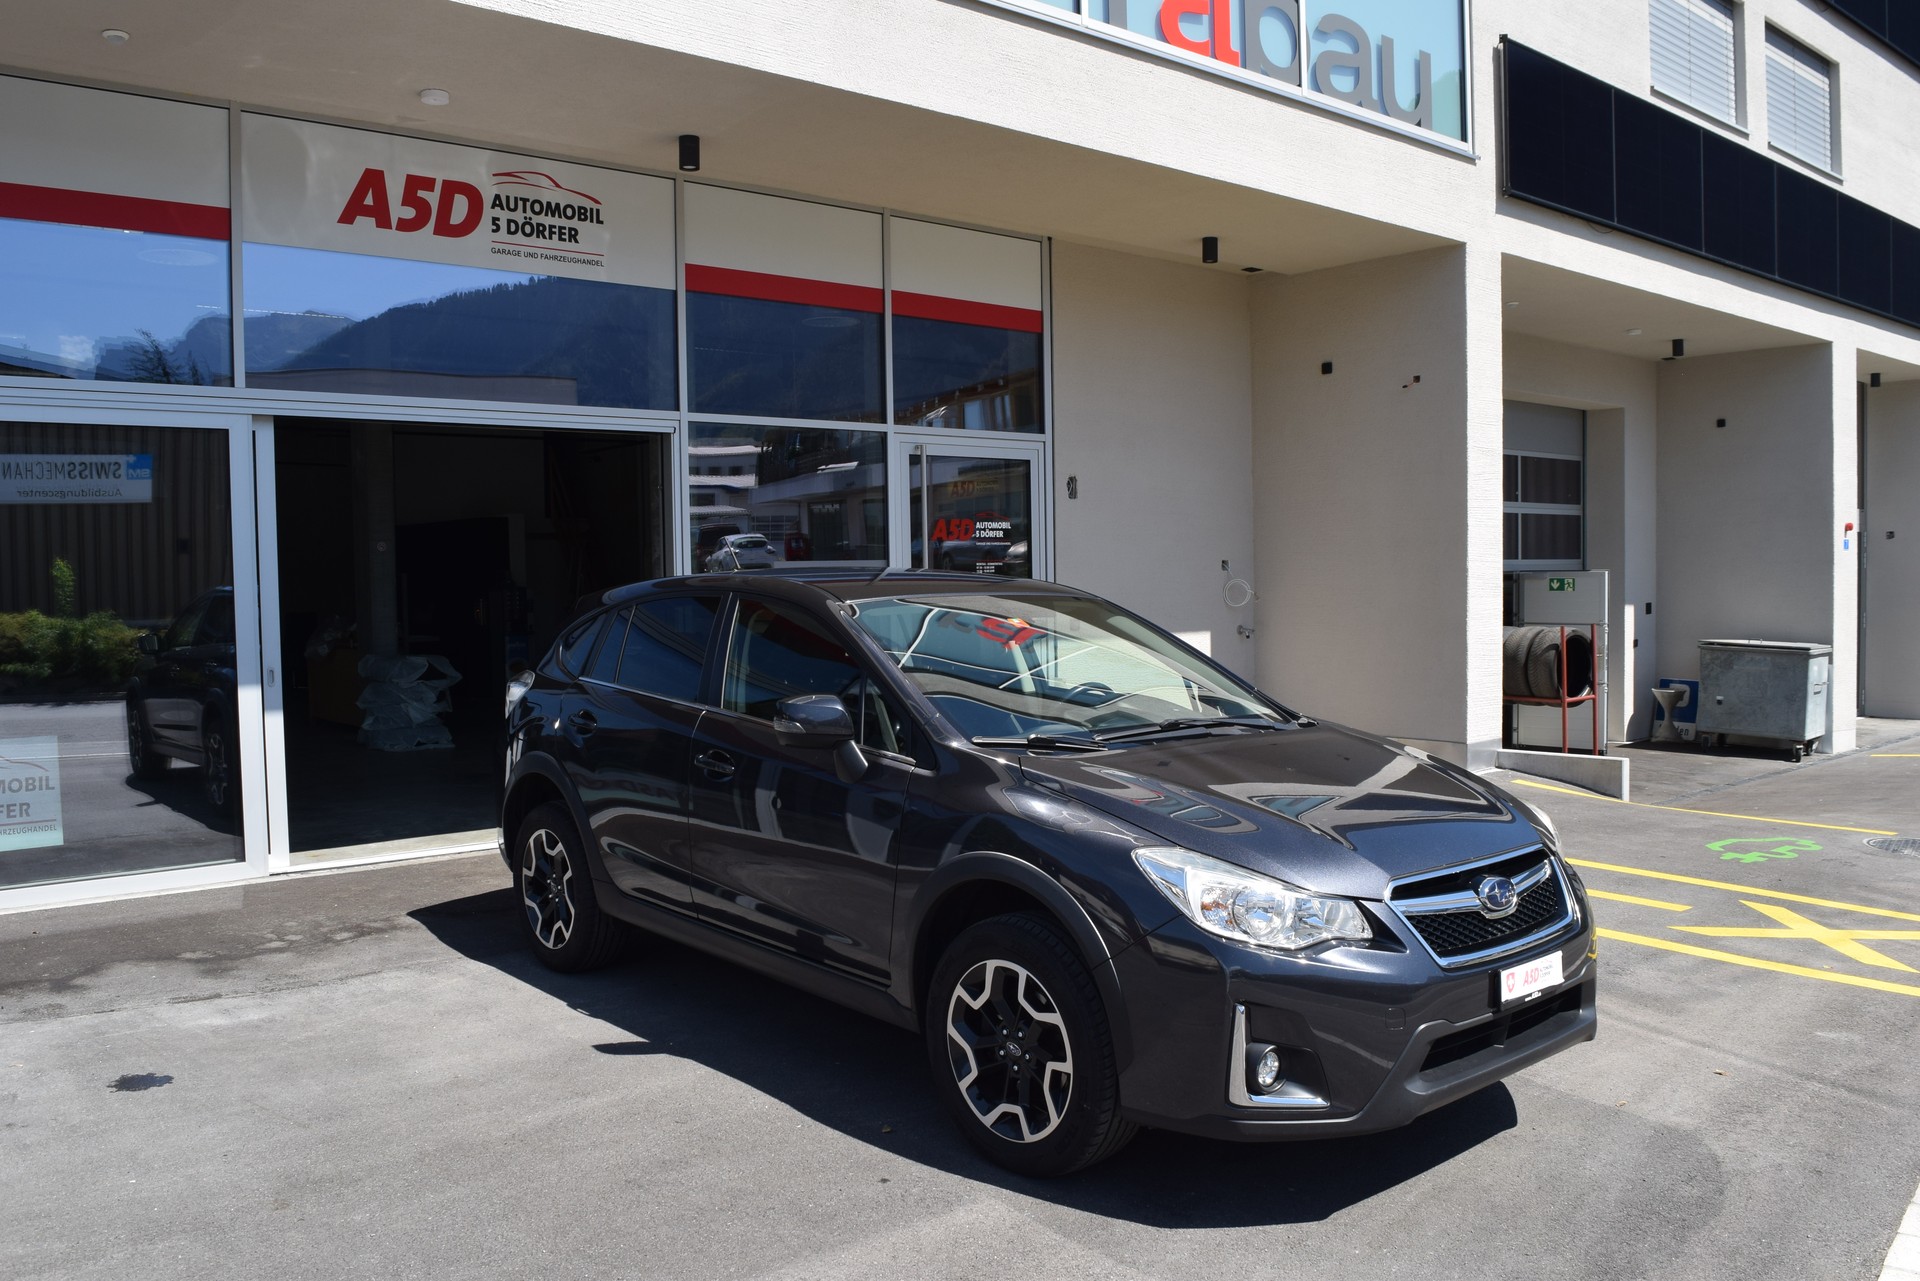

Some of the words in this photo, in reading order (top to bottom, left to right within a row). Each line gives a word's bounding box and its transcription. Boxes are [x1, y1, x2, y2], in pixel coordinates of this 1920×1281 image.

[337, 168, 484, 238] A5D
[490, 193, 604, 225] AUTOMOBIL
[491, 216, 501, 234] 5
[506, 215, 580, 244] DÖRFER
[490, 247, 522, 257] GARAGE
[523, 251, 539, 259] UND
[540, 253, 604, 267] FAHRZEUGHANDEL
[931, 517, 975, 542] A5D
[975, 521, 1011, 529] AUTOMOBIL
[975, 530, 980, 538] 5
[980, 529, 1004, 538] DÖRFER
